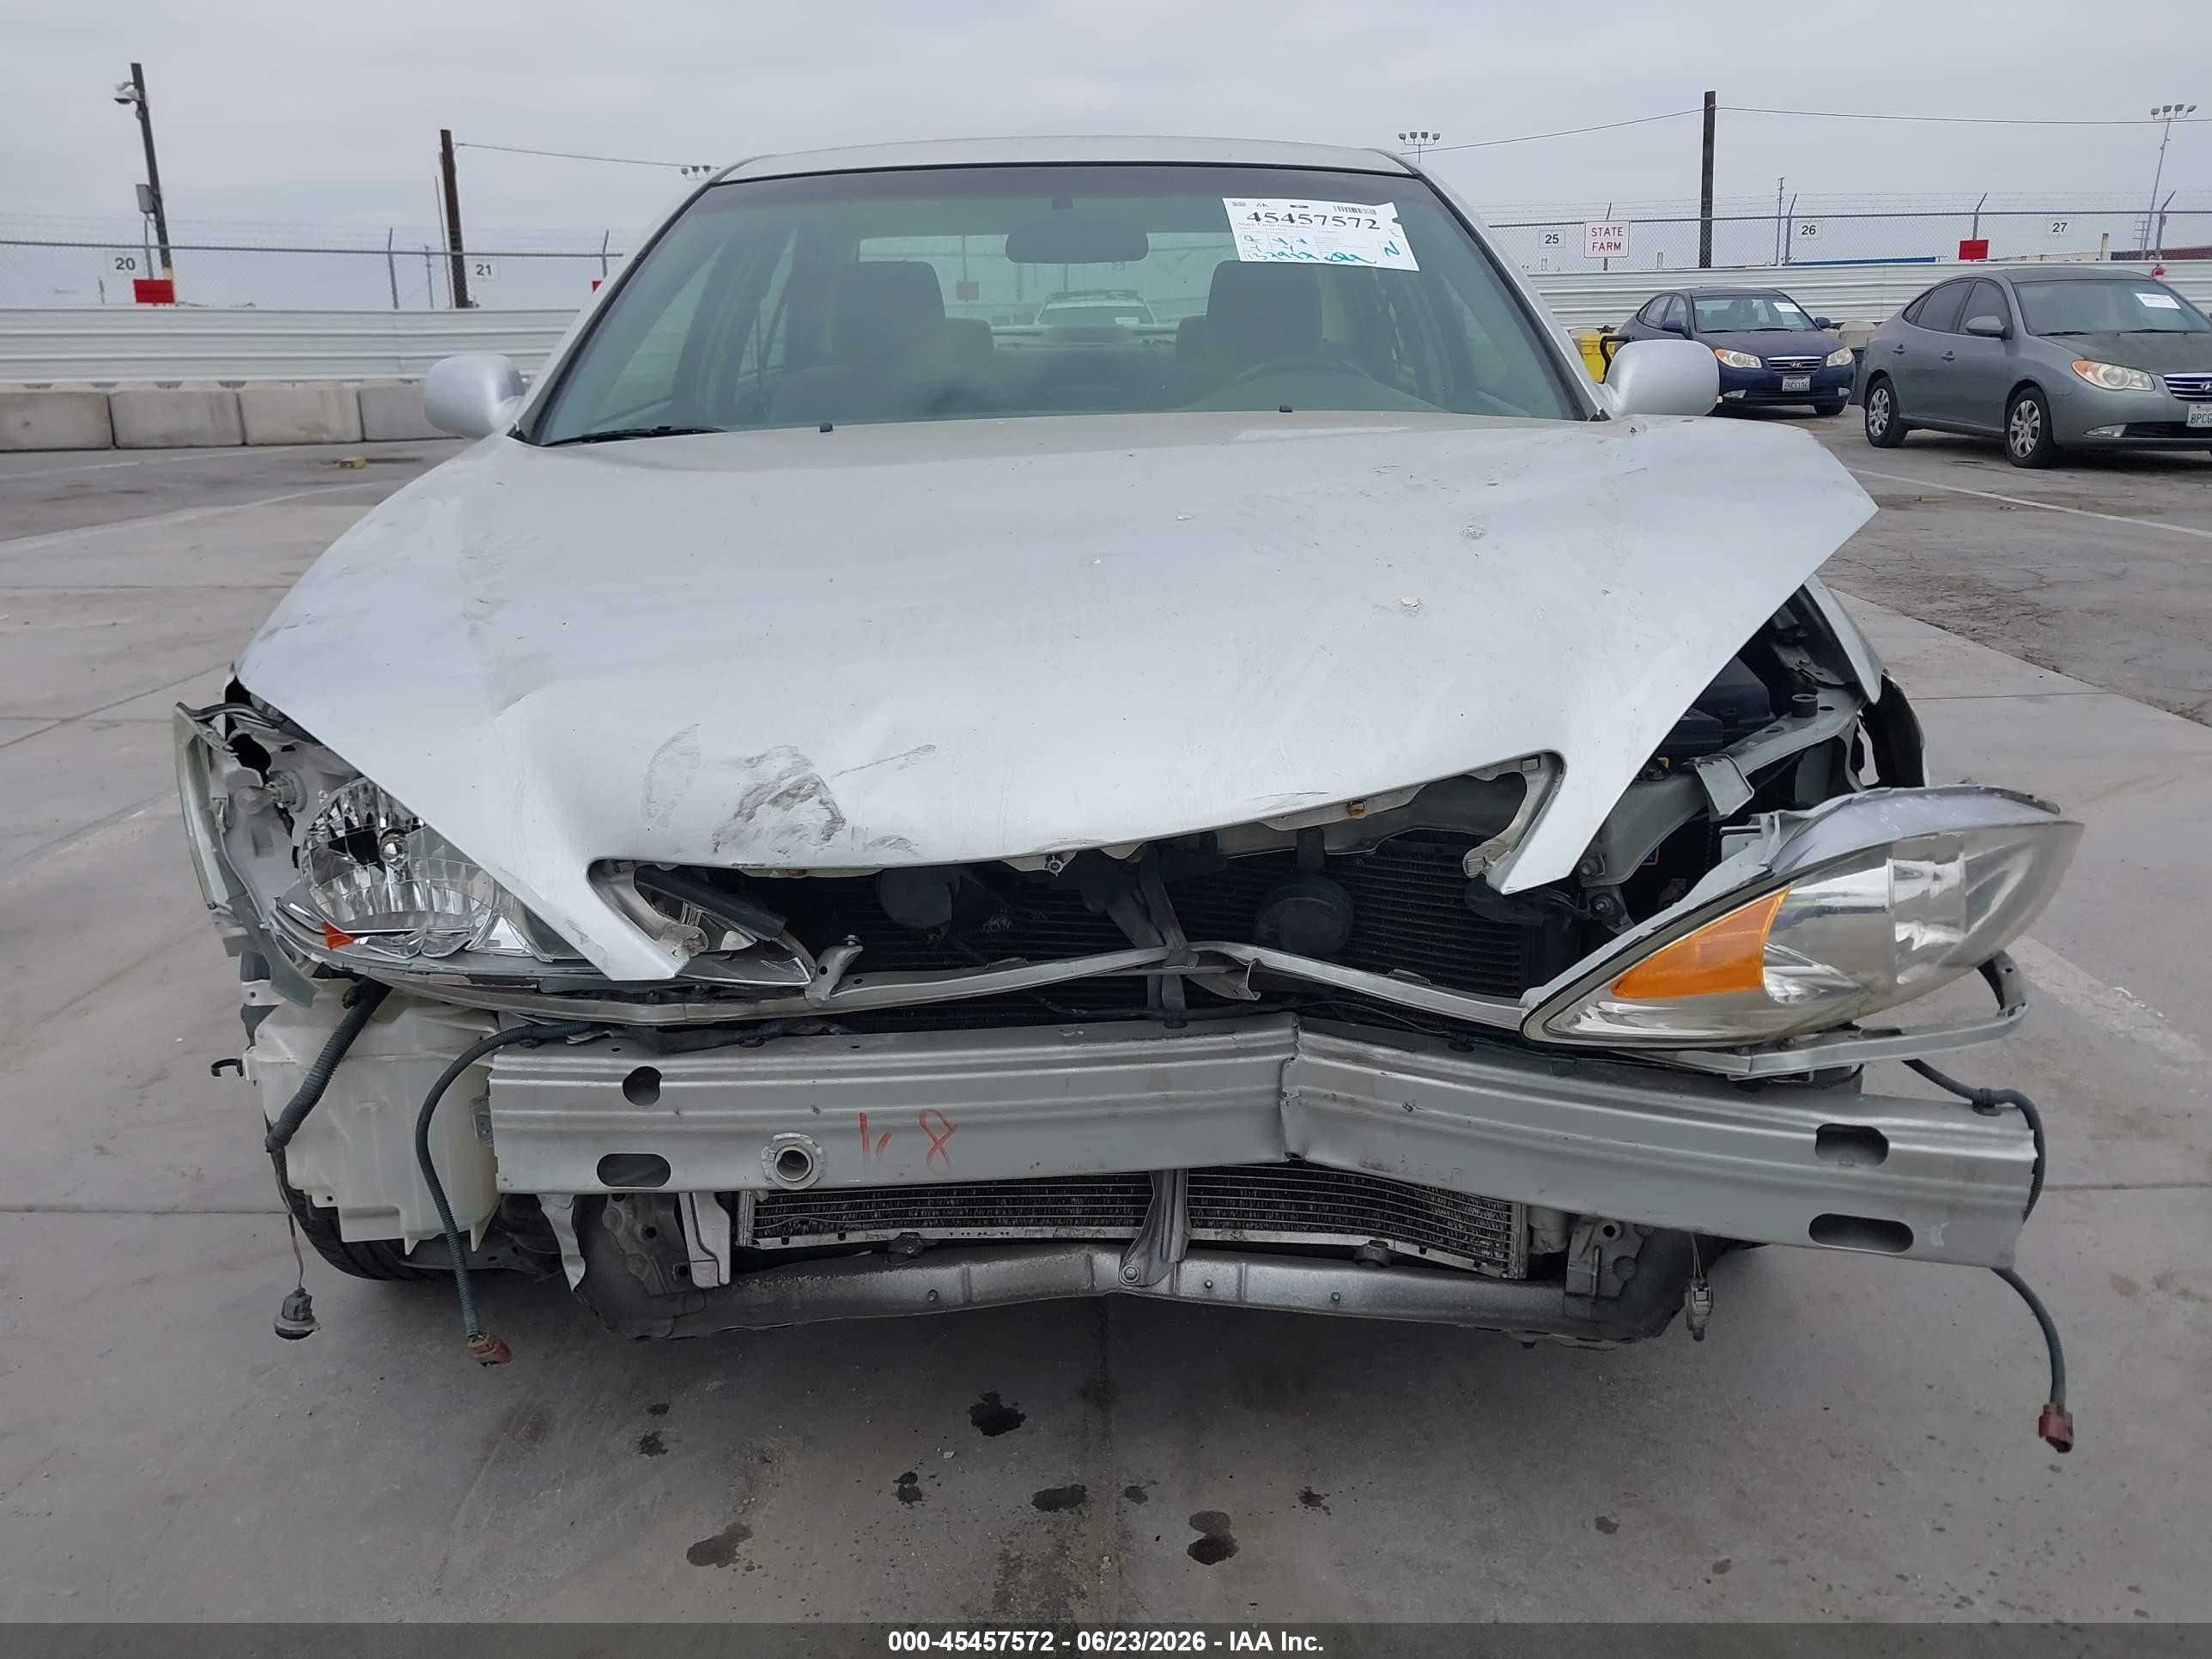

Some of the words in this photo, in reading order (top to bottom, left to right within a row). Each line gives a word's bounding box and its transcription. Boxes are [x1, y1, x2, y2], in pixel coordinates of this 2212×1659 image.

[1246, 211, 1380, 230] 45457572
[1591, 227, 1624, 237] STATE
[1802, 224, 1816, 235] 26
[2052, 222, 2068, 233] 27
[1545, 234, 1559, 245] 25
[1592, 242, 1621, 252] FARM
[115, 257, 136, 270] 20
[476, 264, 492, 276] 21
